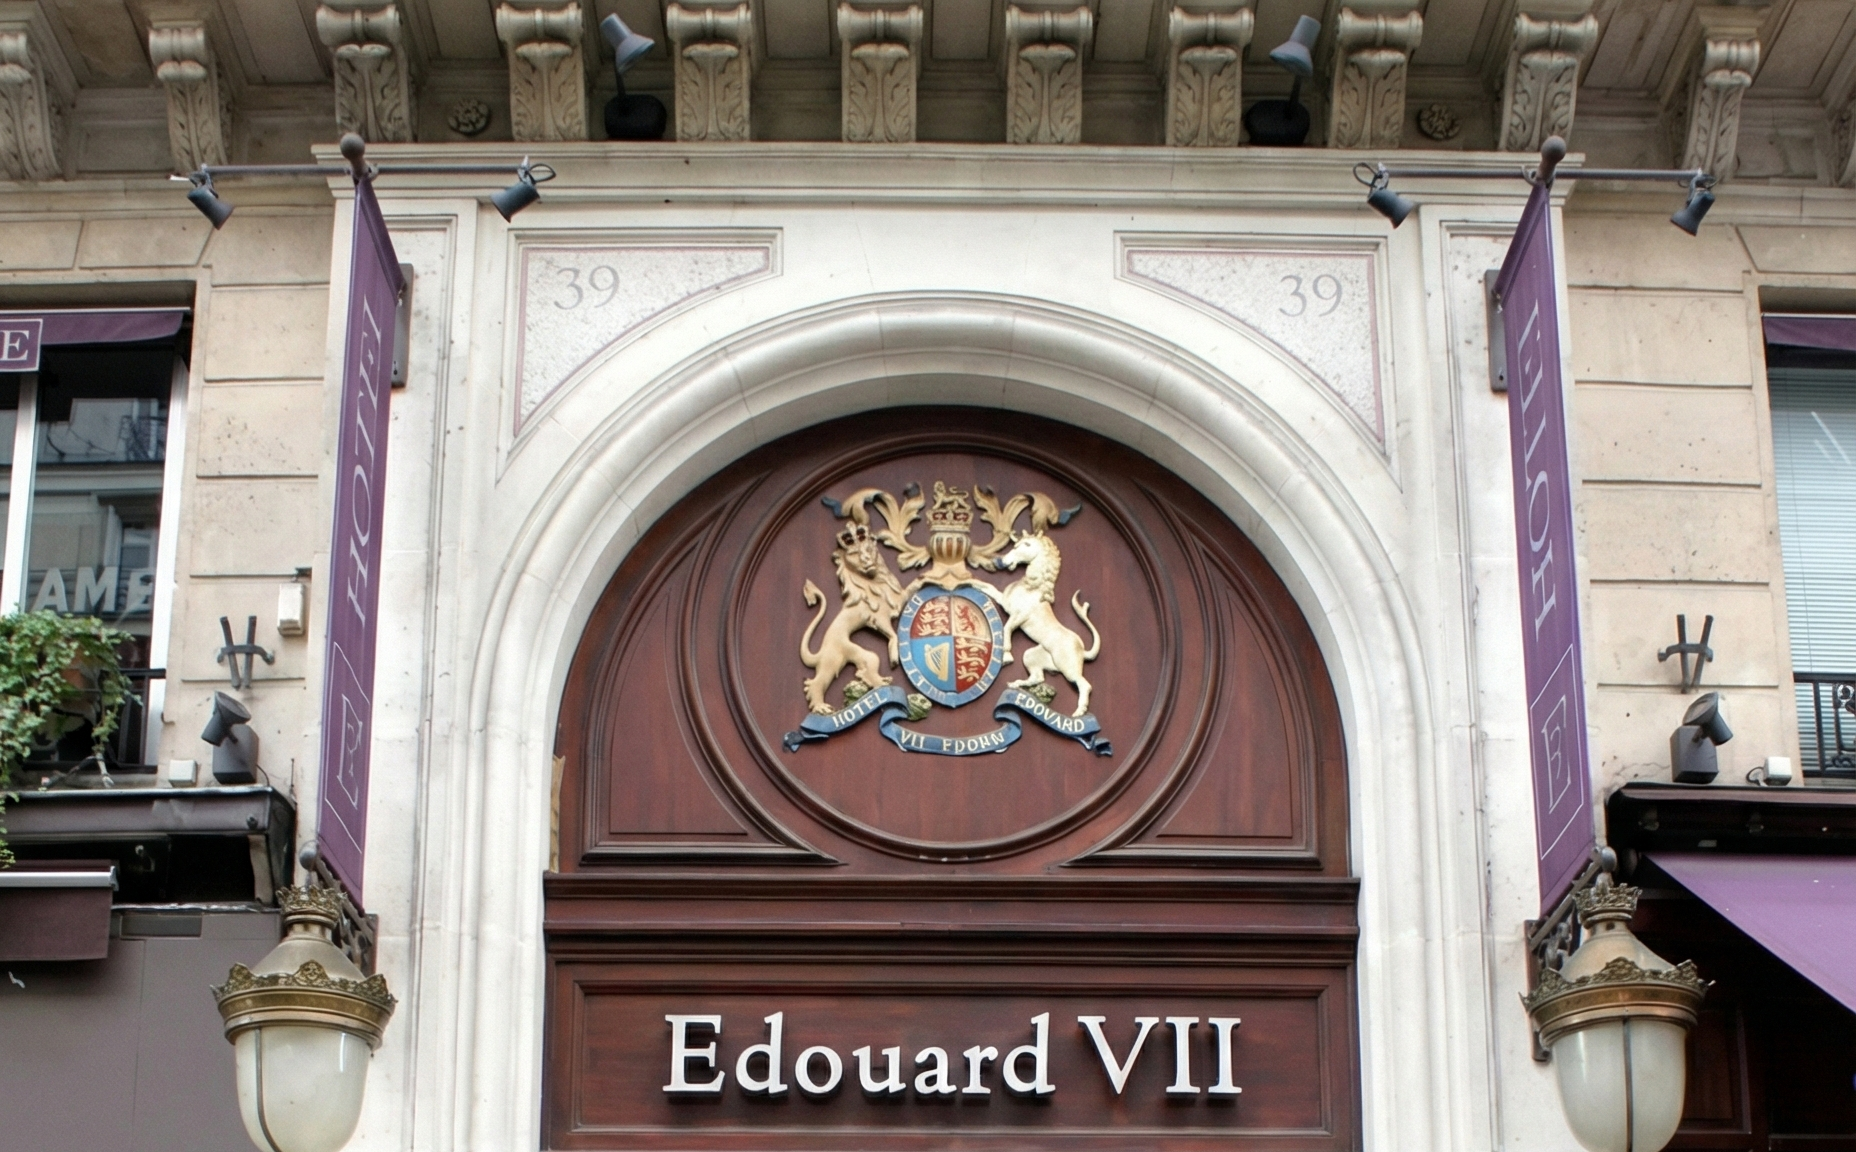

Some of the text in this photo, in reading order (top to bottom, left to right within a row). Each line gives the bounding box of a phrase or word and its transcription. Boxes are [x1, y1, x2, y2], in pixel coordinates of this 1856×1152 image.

[553, 264, 620, 310] 39
[1278, 273, 1343, 317] 39
[831, 691, 888, 728] HOTEL
[901, 730, 925, 749] VII
[662, 1011, 1243, 1096] Edouard VII
